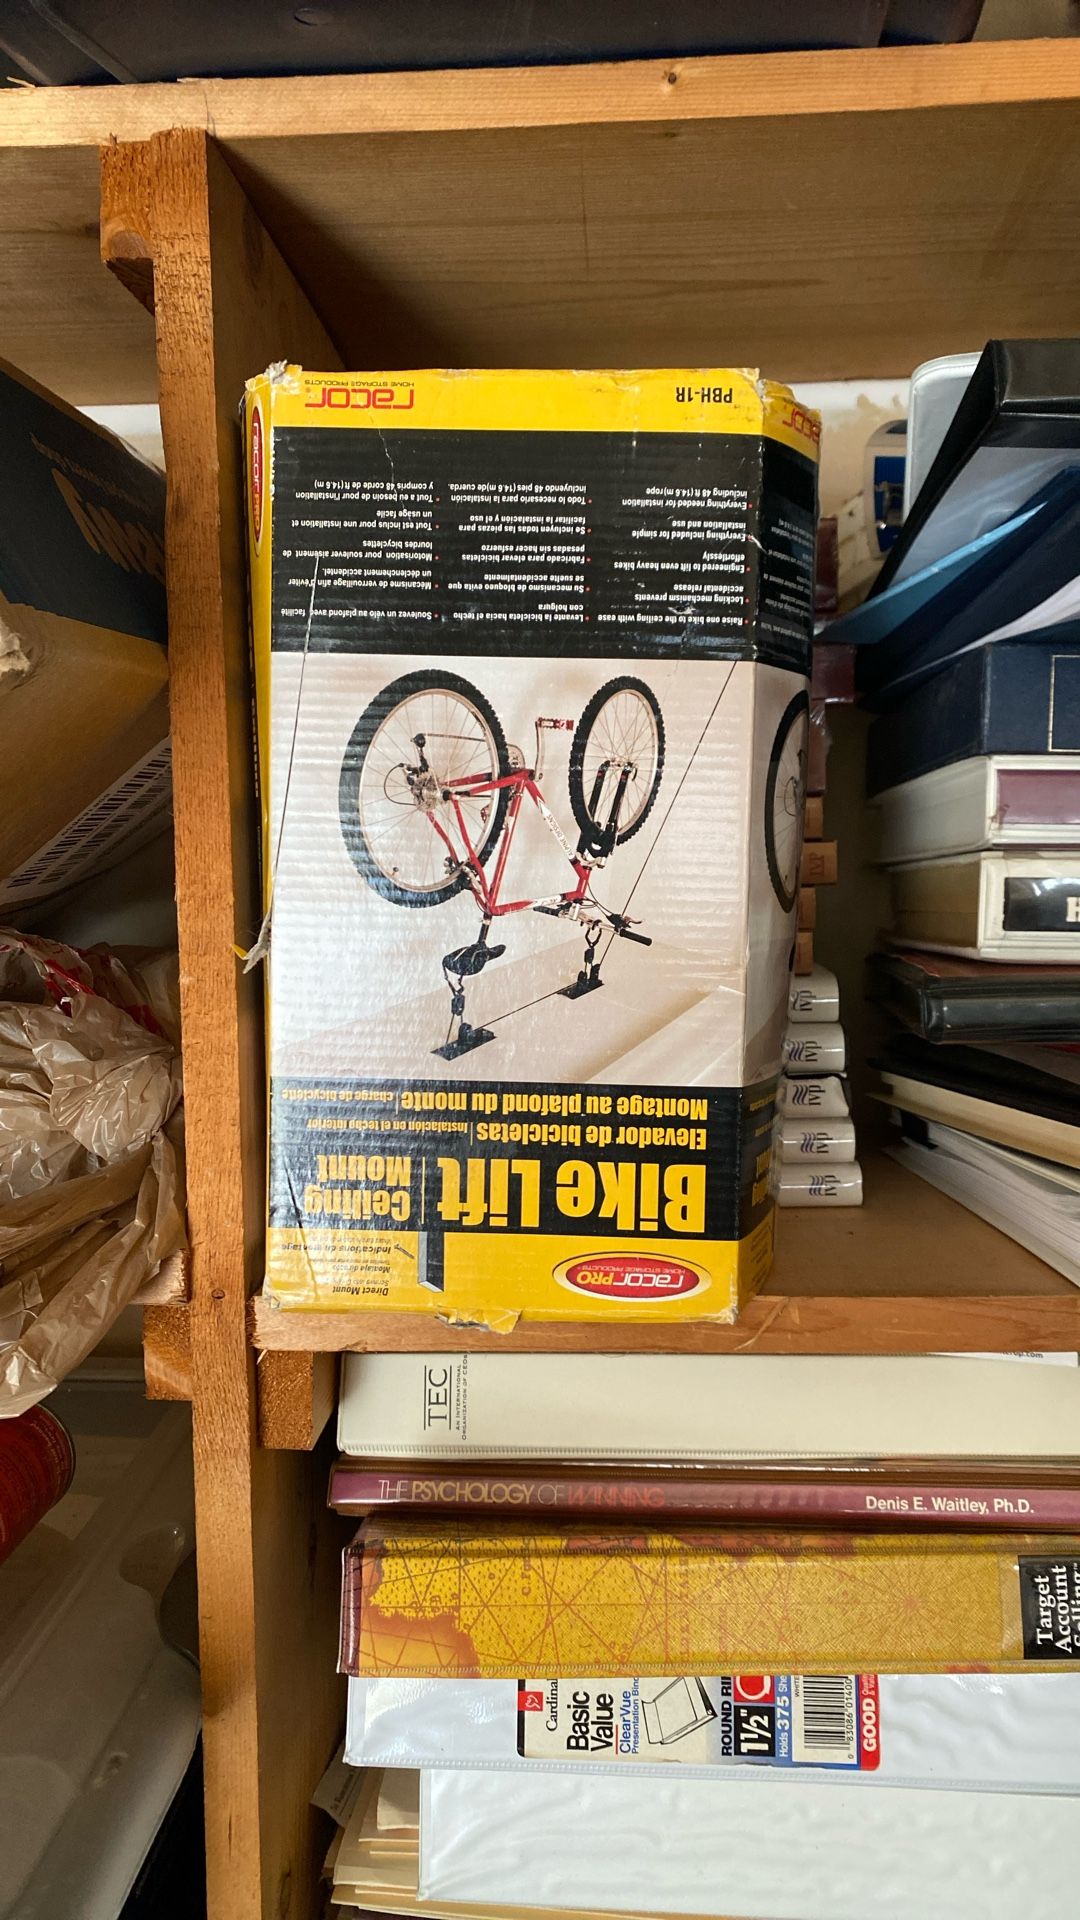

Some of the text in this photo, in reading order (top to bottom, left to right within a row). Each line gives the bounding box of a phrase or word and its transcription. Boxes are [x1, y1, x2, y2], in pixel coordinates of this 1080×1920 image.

[305, 388, 414, 409] racor
[675, 386, 733, 403] PBH-1R
[451, 494, 586, 505] Todo lo necesario para la instalación
[622, 499, 747, 510] Everything needed for installation
[376, 510, 397, 519] facile
[398, 509, 421, 518] usage
[459, 523, 585, 535] Se incluyen todas las piezas para
[688, 521, 702, 529] and
[704, 521, 746, 530] installation
[632, 529, 746, 541] Everything included for simple
[363, 538, 433, 550] lourdes bicyclettes
[481, 544, 585, 554] pesadas sin hacer esfuerzo
[462, 553, 585, 564] Fabricado para elevar bicicletas
[702, 551, 745, 562] effortlessly
[614, 562, 635, 570] bikes
[637, 561, 660, 571] heavy
[681, 563, 692, 572] lift
[693, 563, 701, 572] to
[702, 562, 745, 573] Engineered
[322, 569, 363, 577] accidentel.
[364, 569, 421, 578] déclenchement
[484, 574, 548, 583] accidentalmente
[550, 575, 574, 583] suelte
[673, 584, 744, 594] accidental release
[634, 592, 744, 604] Locking mechanism prevents
[538, 602, 568, 612] holgura
[453, 612, 584, 622] Levante la bicicleta hacia el techo
[618, 615, 635, 624] with
[637, 614, 664, 624] ceiling
[665, 616, 677, 624] the
[679, 616, 687, 625] to
[688, 616, 705, 625] bike
[722, 617, 743, 626] Raise
[282, 1088, 393, 1102] charge de bicyclette
[401, 1092, 708, 1120] Montage au plafond du monte
[307, 1118, 468, 1134] Instalación en el techo interior
[477, 1122, 707, 1150] Elevador de bicicletas
[316, 1154, 411, 1186] Mount
[436, 1157, 540, 1228] Lift
[556, 1160, 706, 1233] Bike
[304, 1184, 410, 1221] Ceiling
[576, 1271, 684, 1288] racor PRO
[332, 1286, 389, 1296] Direct Mount
[428, 1368, 448, 1427] TEC
[378, 1480, 666, 1507] THE PSYCHOLOGY OF WINNING
[866, 1496, 1035, 1515] Denis E. Waitley, Ph.D.
[1034, 1575, 1056, 1645] Target
[1051, 1565, 1072, 1654] Account
[845, 1679, 853, 1708] 01400
[546, 1678, 558, 1732] Cardinal
[777, 1696, 790, 1730] 375
[566, 1690, 590, 1751] Basic
[590, 1693, 614, 1752] Value
[620, 1690, 631, 1753] ClearVue
[846, 1712, 854, 1741] 83086
[862, 1698, 877, 1752] GOOD
[721, 1701, 732, 1756] ROUND
[780, 1732, 788, 1757] Holds
